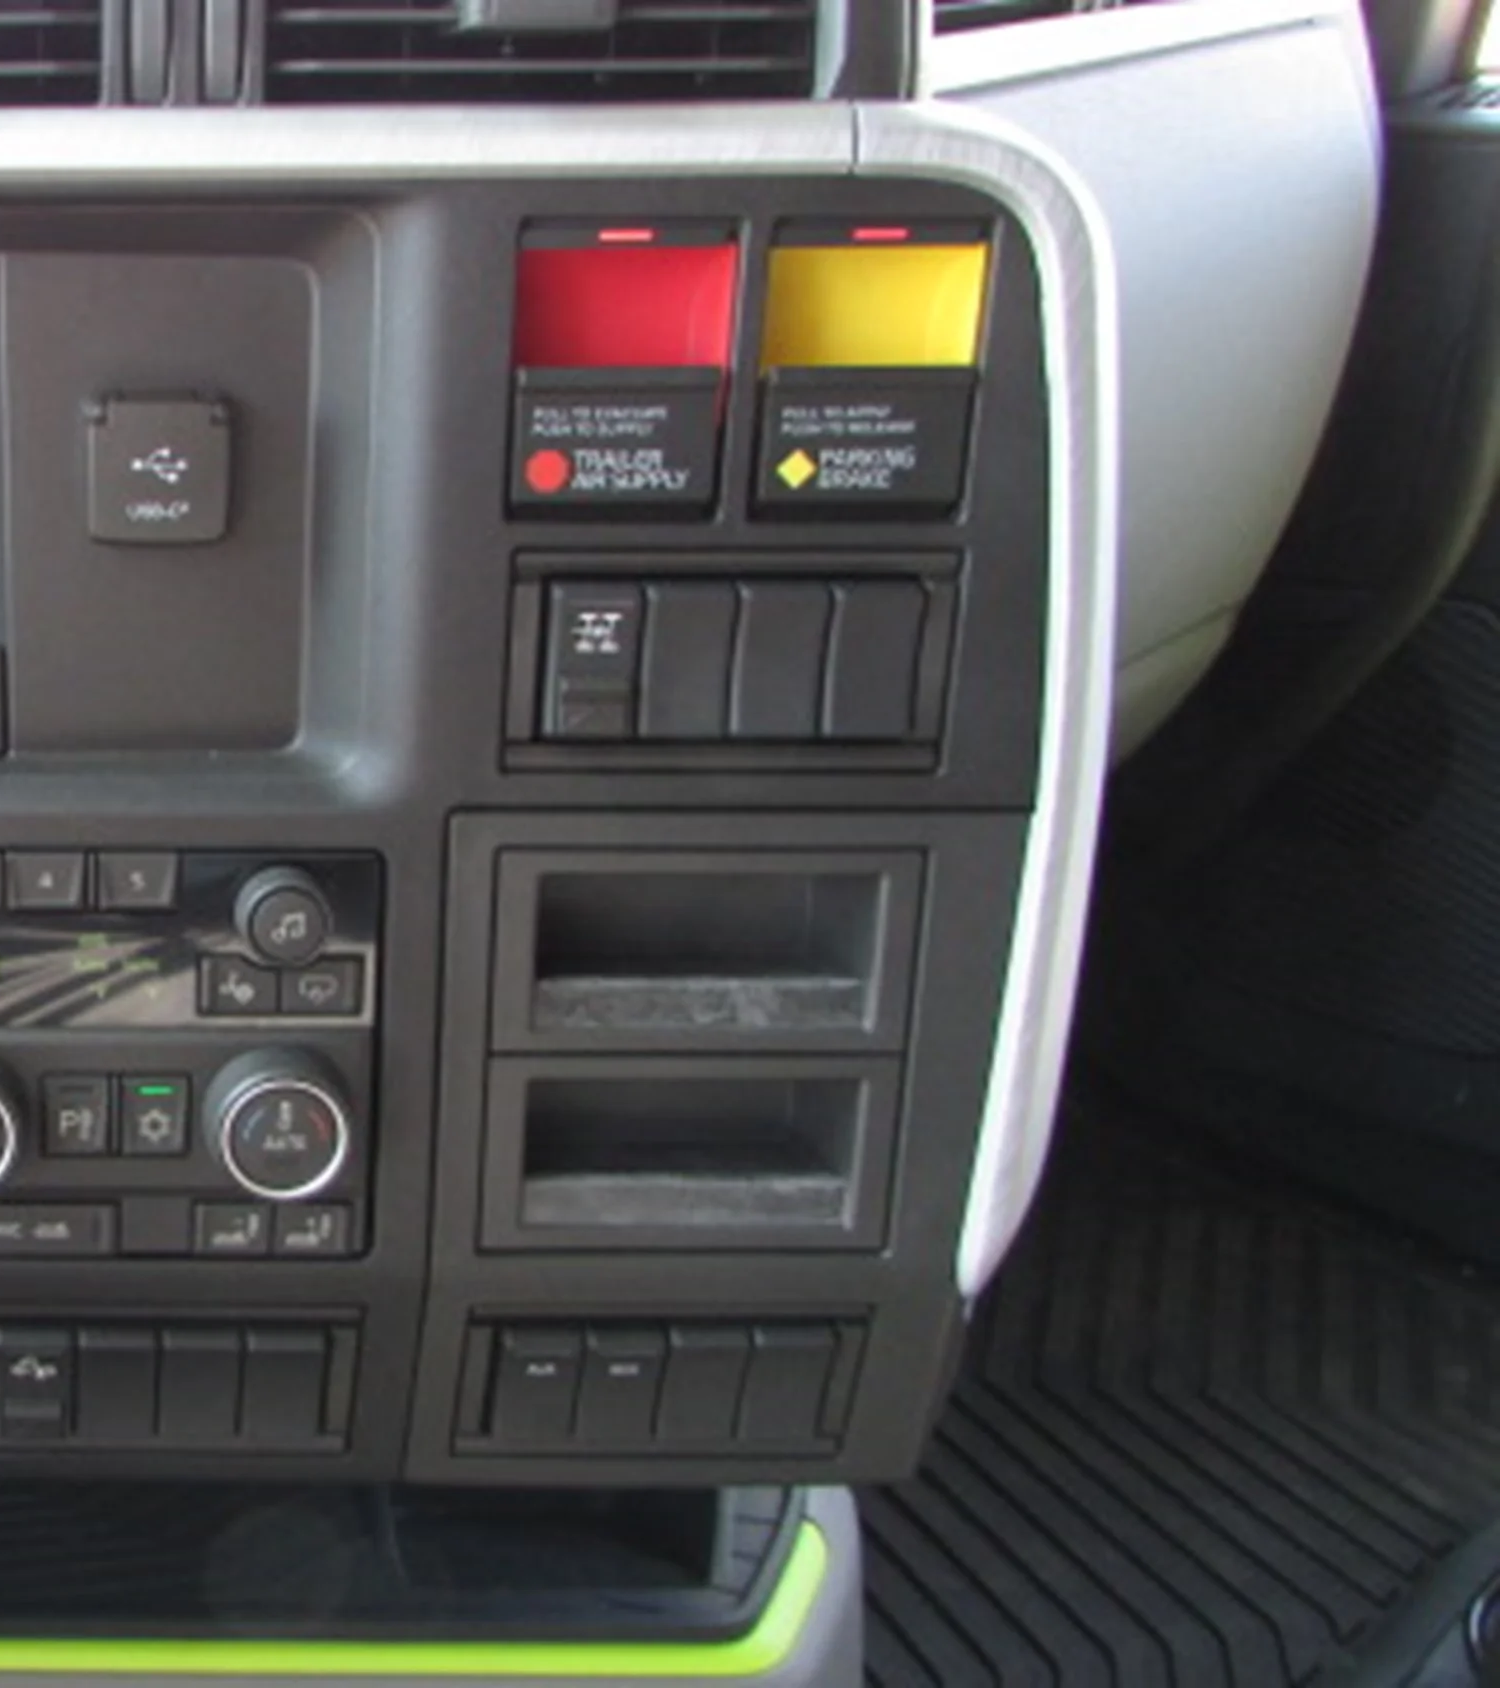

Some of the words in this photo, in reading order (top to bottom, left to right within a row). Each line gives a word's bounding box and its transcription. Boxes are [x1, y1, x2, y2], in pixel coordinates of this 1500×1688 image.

[573, 449, 664, 471] TRAILER
[818, 447, 916, 469] PARKING
[609, 469, 690, 490] SUPPLY
[817, 468, 891, 490] BRAKE
